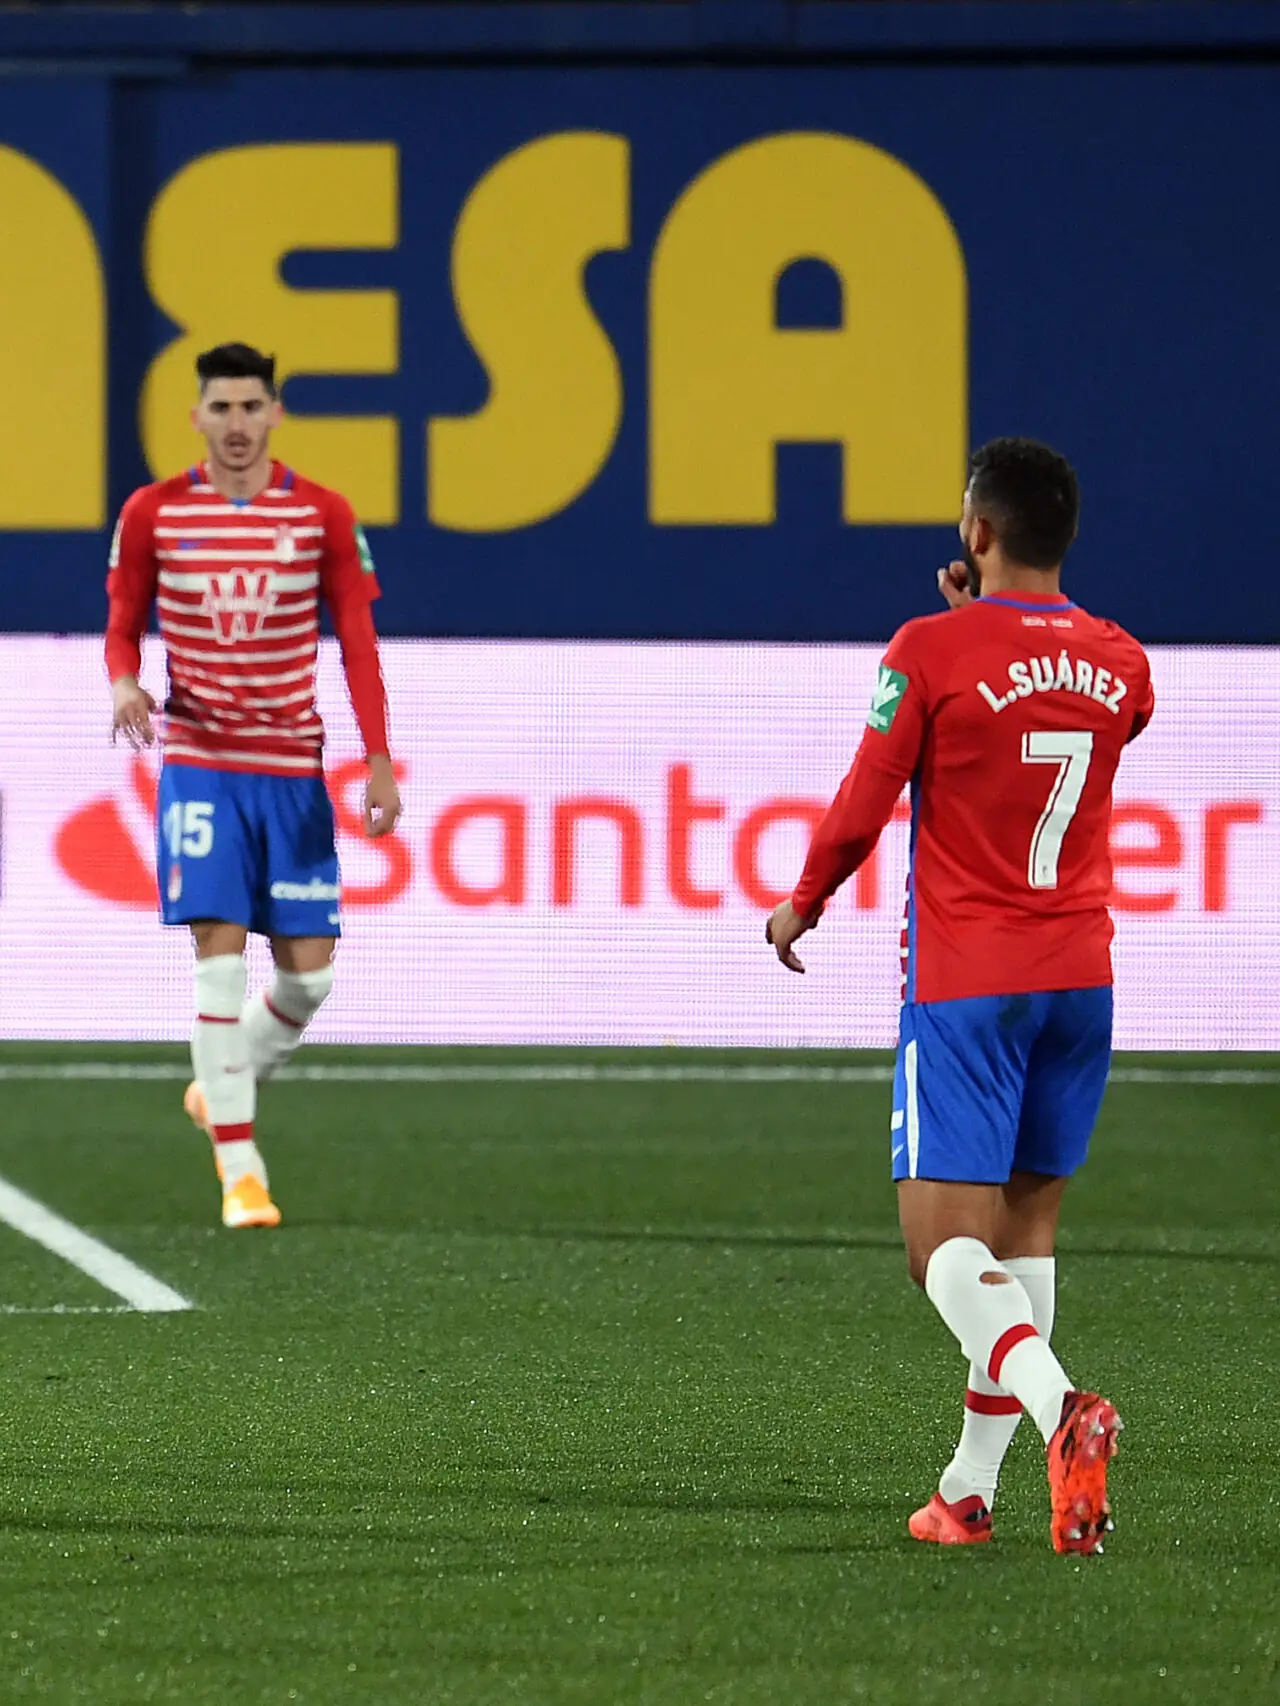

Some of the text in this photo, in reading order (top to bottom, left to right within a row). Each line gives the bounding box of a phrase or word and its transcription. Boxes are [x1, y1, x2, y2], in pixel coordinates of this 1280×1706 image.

[976, 649, 1127, 715] L.SUÁREZ
[163, 800, 215, 858] 15
[323, 758, 1264, 913] Santaer
[1021, 731, 1094, 889] 7
